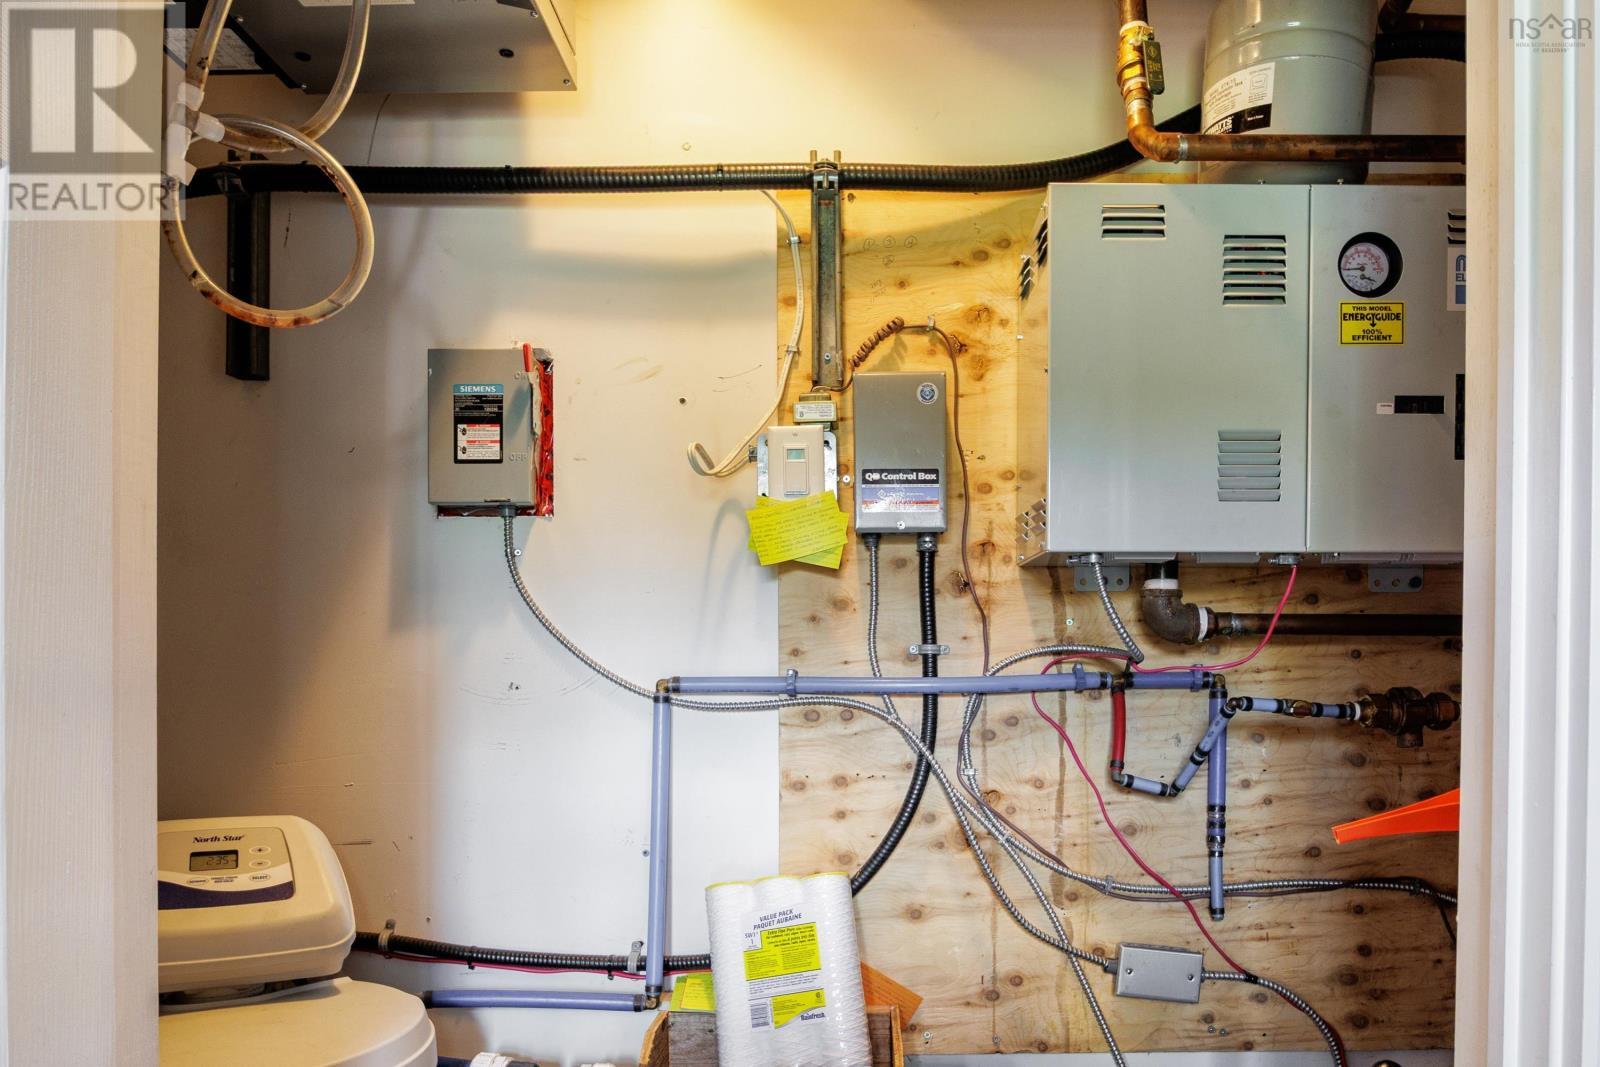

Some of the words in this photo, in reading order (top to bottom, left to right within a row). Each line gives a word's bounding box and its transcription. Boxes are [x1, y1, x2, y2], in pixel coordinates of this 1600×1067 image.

[459, 385, 496, 393] SIEMENS
[509, 453, 526, 461] OFF
[881, 472, 917, 480] Control
[917, 472, 937, 480] Box
[222, 834, 245, 842] Star
[760, 912, 778, 922] VALUE
[778, 909, 794, 918] PACK
[753, 920, 775, 930] PAQUET
[776, 913, 802, 925] AUBAINE
